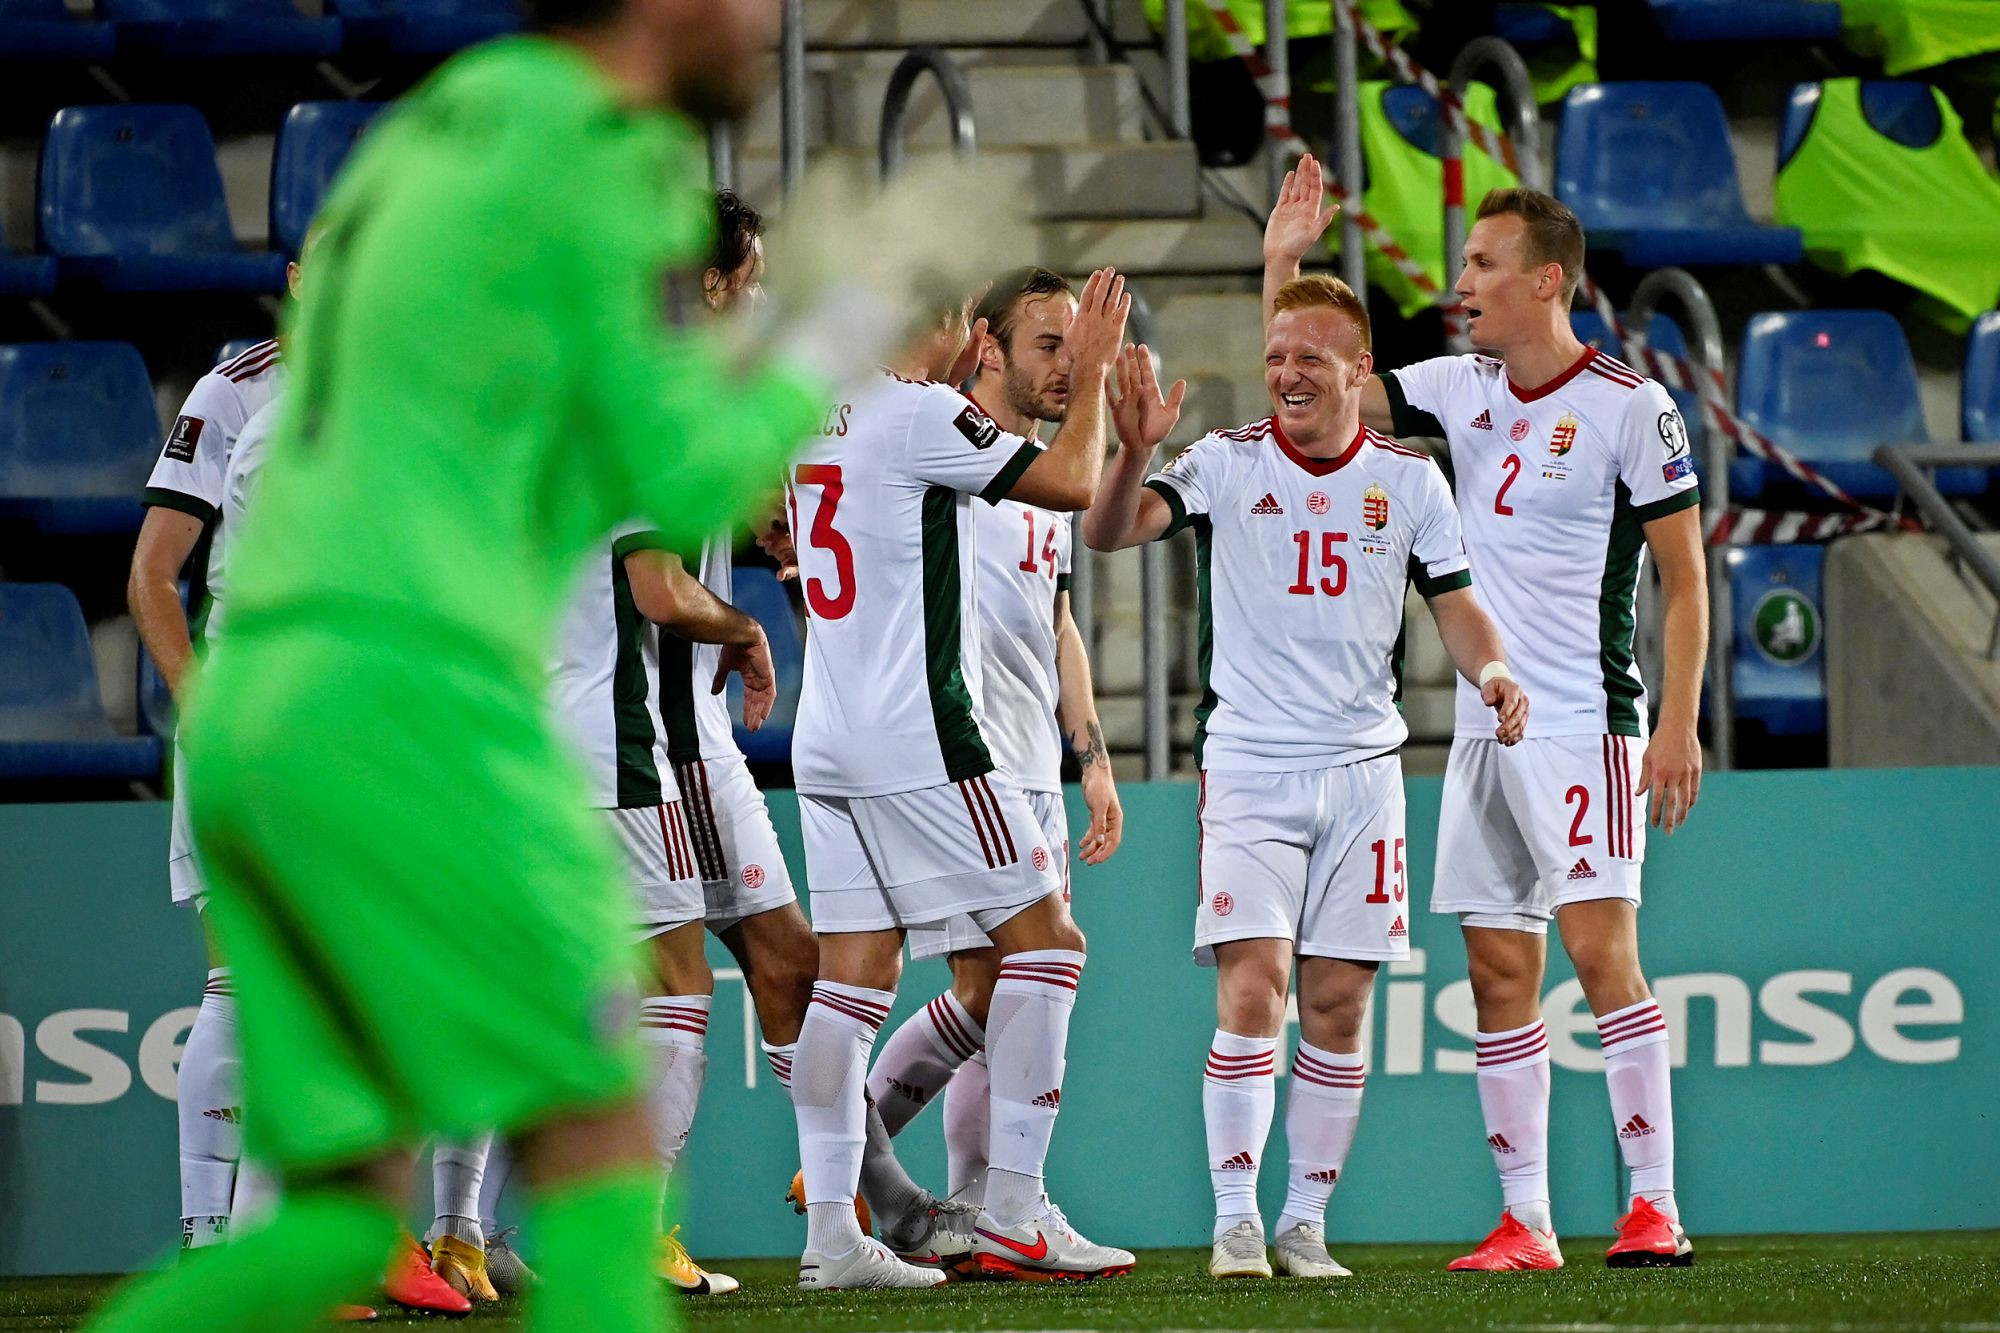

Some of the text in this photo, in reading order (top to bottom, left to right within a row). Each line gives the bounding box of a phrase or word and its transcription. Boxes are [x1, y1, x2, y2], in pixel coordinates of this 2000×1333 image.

[1250, 506, 1284, 515] adidas
[1495, 453, 1521, 517] 2
[1019, 510, 1057, 580] 14
[1288, 530, 1348, 597] 15
[1565, 784, 1594, 847] 2
[1366, 838, 1404, 904] 15
[1567, 870, 1597, 880] adidas
